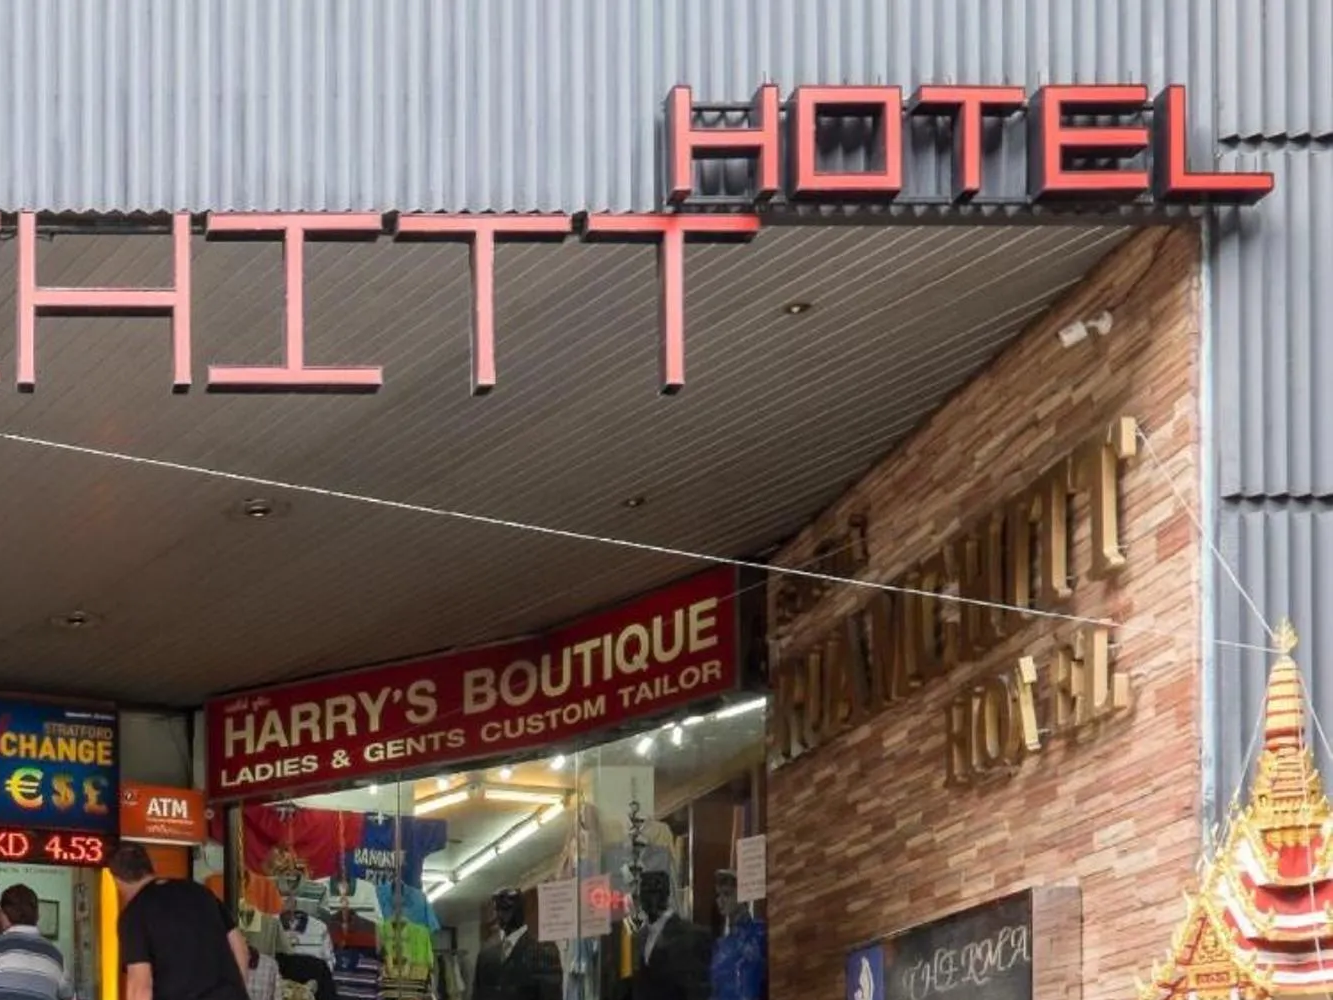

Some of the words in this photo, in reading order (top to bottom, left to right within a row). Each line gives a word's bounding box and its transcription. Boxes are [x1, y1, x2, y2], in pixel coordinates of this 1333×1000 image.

[670, 84, 1275, 206] HOTEL
[220, 754, 319, 788] LADIES
[330, 748, 351, 769] &
[363, 728, 465, 763] GENTS
[479, 697, 607, 743] CUSTOM
[617, 658, 722, 711] TAILOR
[223, 679, 437, 758] HARRY'S
[462, 596, 719, 714] BOUTIQUE
[44, 835, 104, 862] 4.53
[146, 796, 188, 819] ATM
